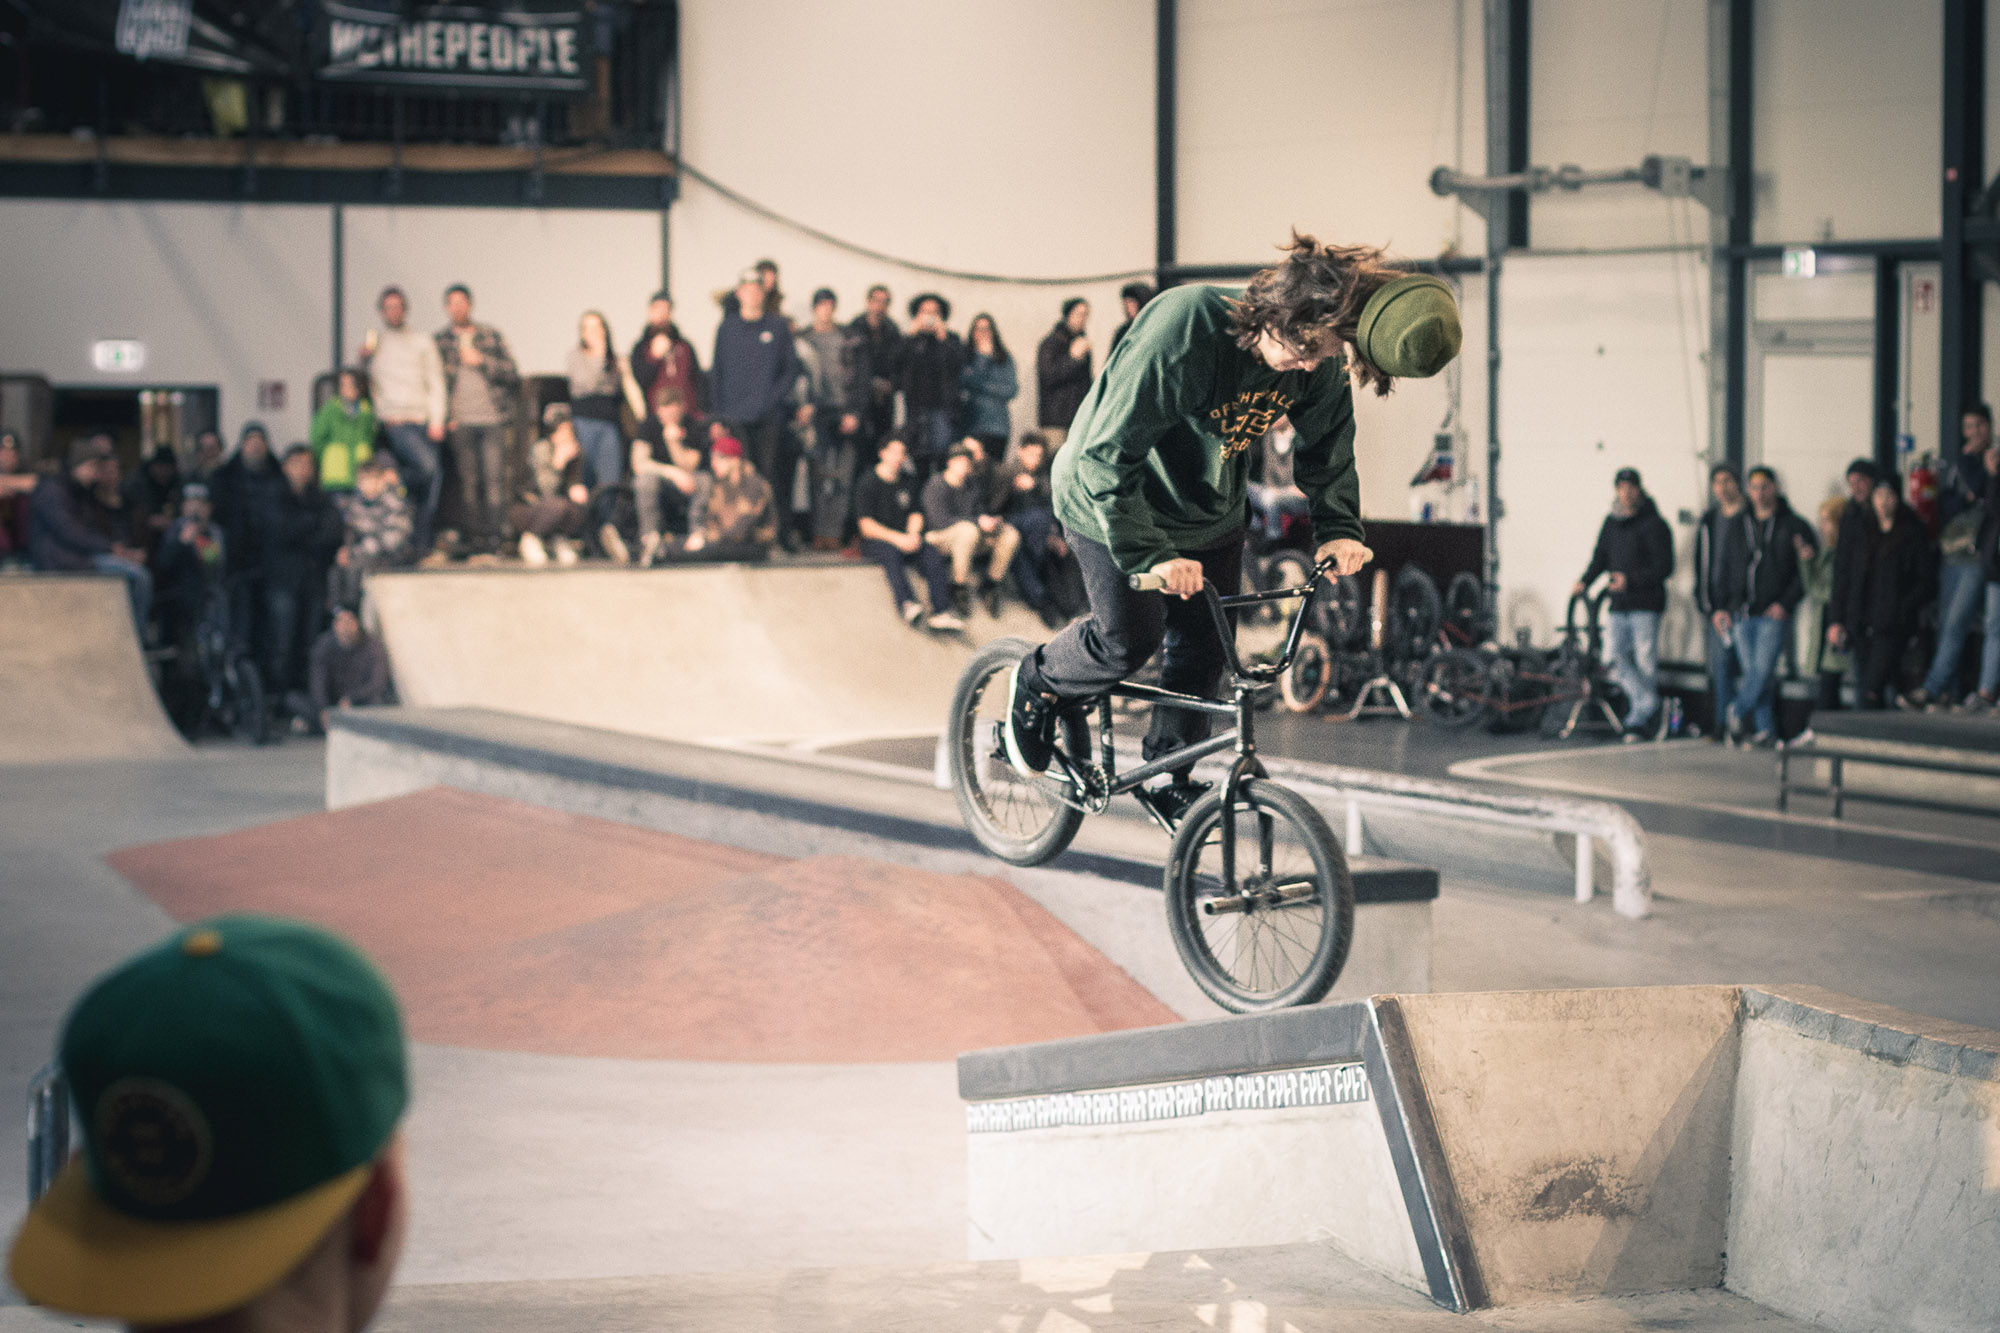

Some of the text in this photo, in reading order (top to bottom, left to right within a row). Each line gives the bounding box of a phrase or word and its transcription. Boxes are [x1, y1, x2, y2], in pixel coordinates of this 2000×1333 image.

[1204, 1077, 1233, 1111] CULT
[1234, 1075, 1265, 1109] CULT
[1267, 1072, 1298, 1107] CULT
[1299, 1069, 1332, 1105] CULT
[1334, 1065, 1367, 1102] CULT
